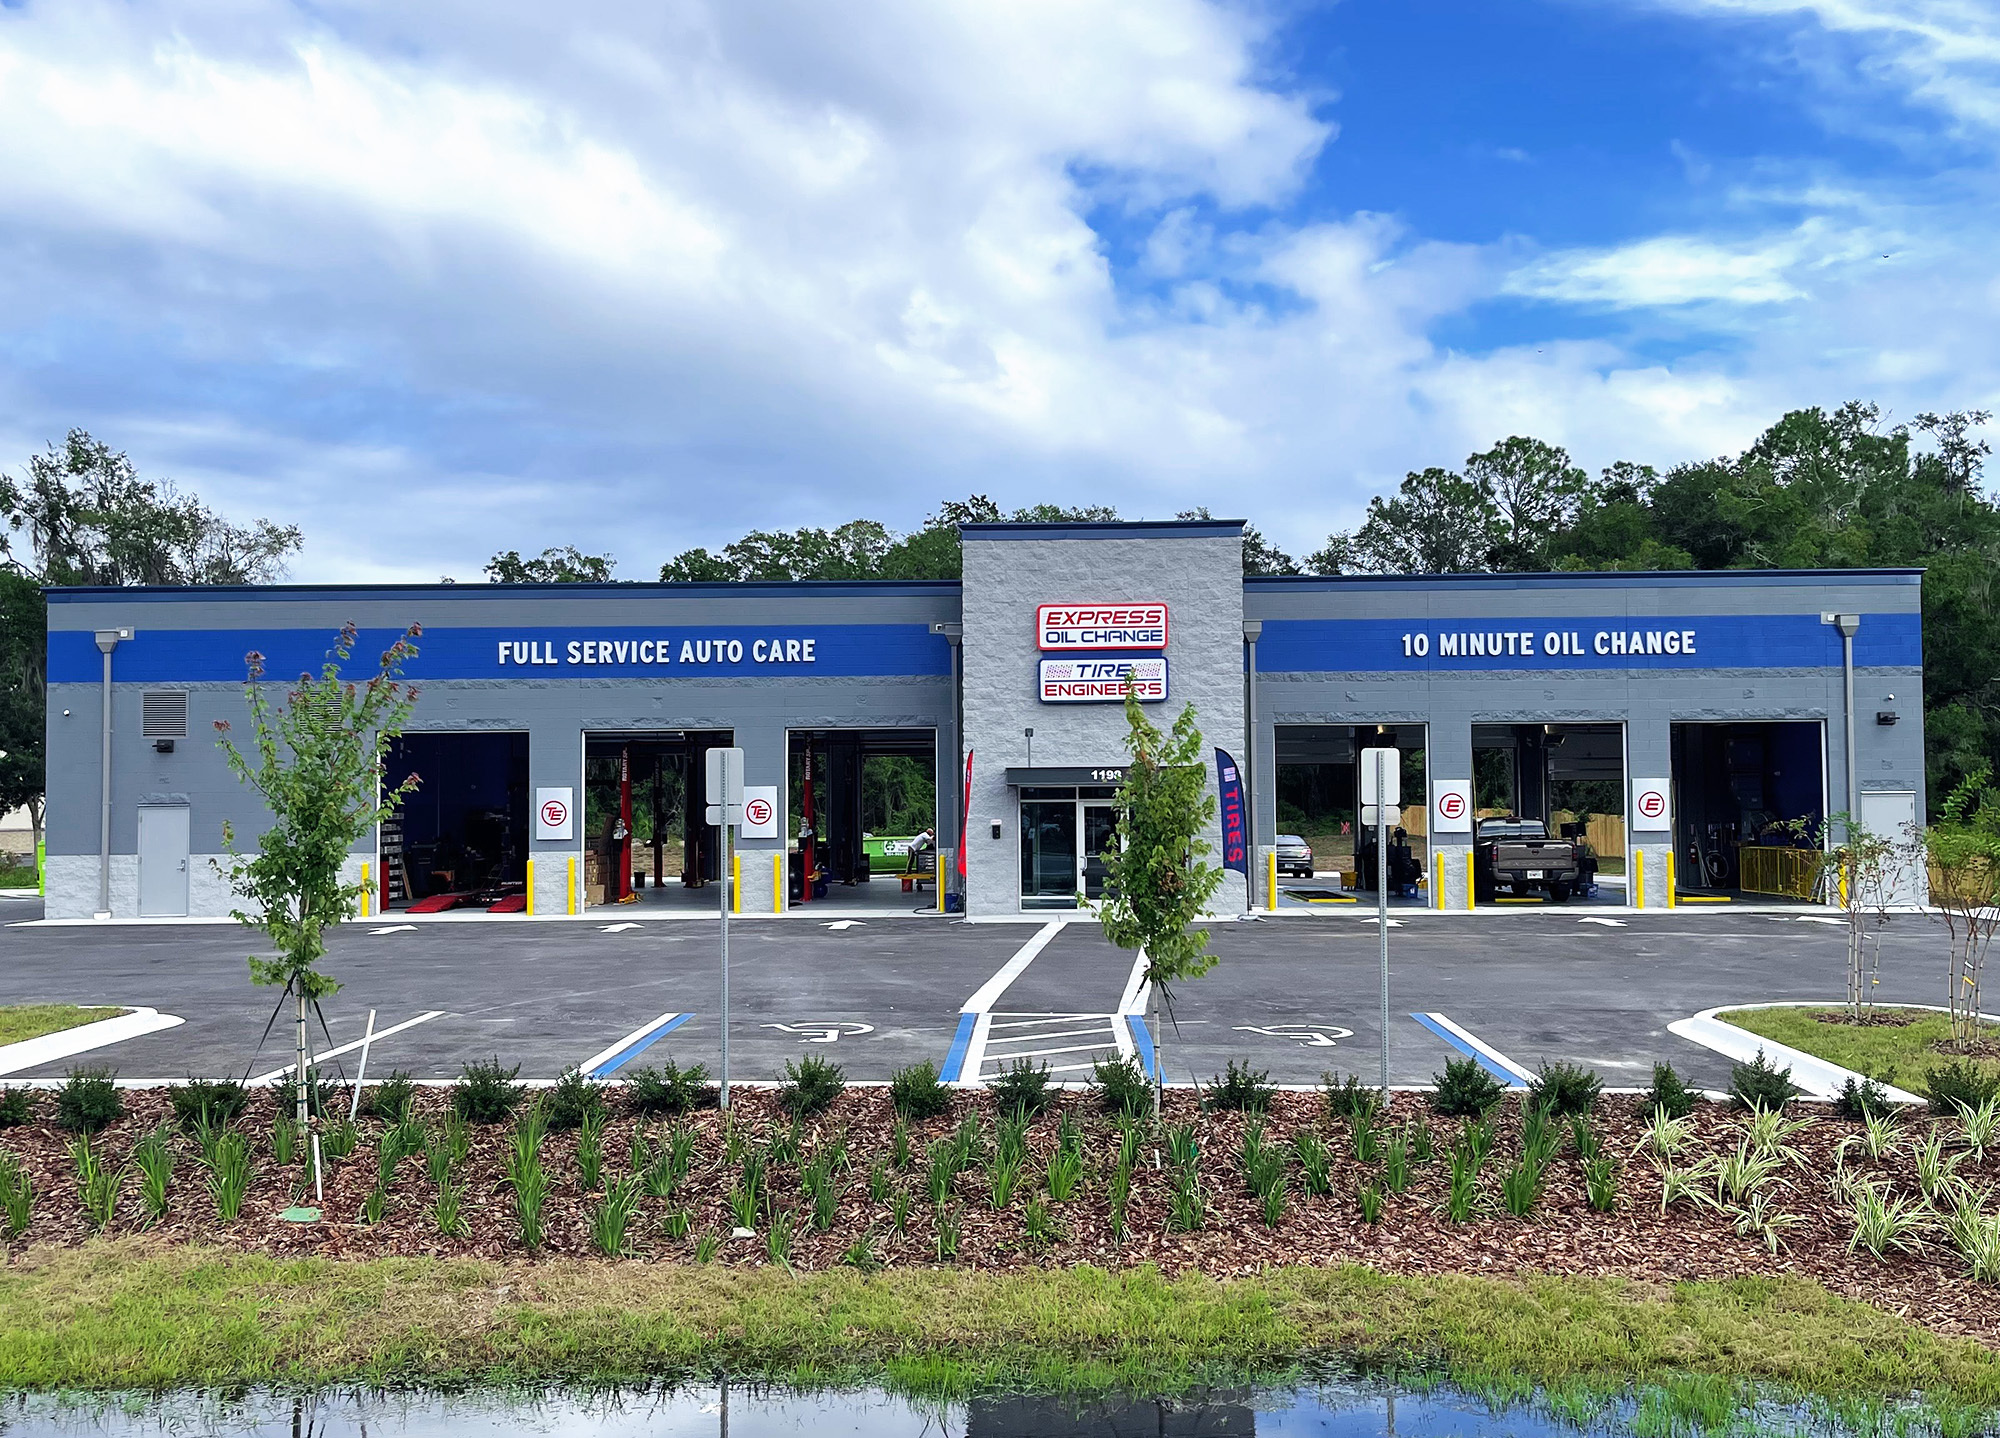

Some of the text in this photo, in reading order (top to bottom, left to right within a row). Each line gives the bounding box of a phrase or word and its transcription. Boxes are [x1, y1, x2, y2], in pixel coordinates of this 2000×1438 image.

[1045, 610, 1162, 626] EXPRESS
[1045, 630, 1163, 644] OIL CHANGE
[1402, 630, 1696, 656] 10 MINUTE OIL CHANGE
[498, 639, 816, 664] FULL SERVICE AUTO CARE
[1076, 664, 1132, 678] TIRE
[1225, 786, 1243, 862] TIRES
